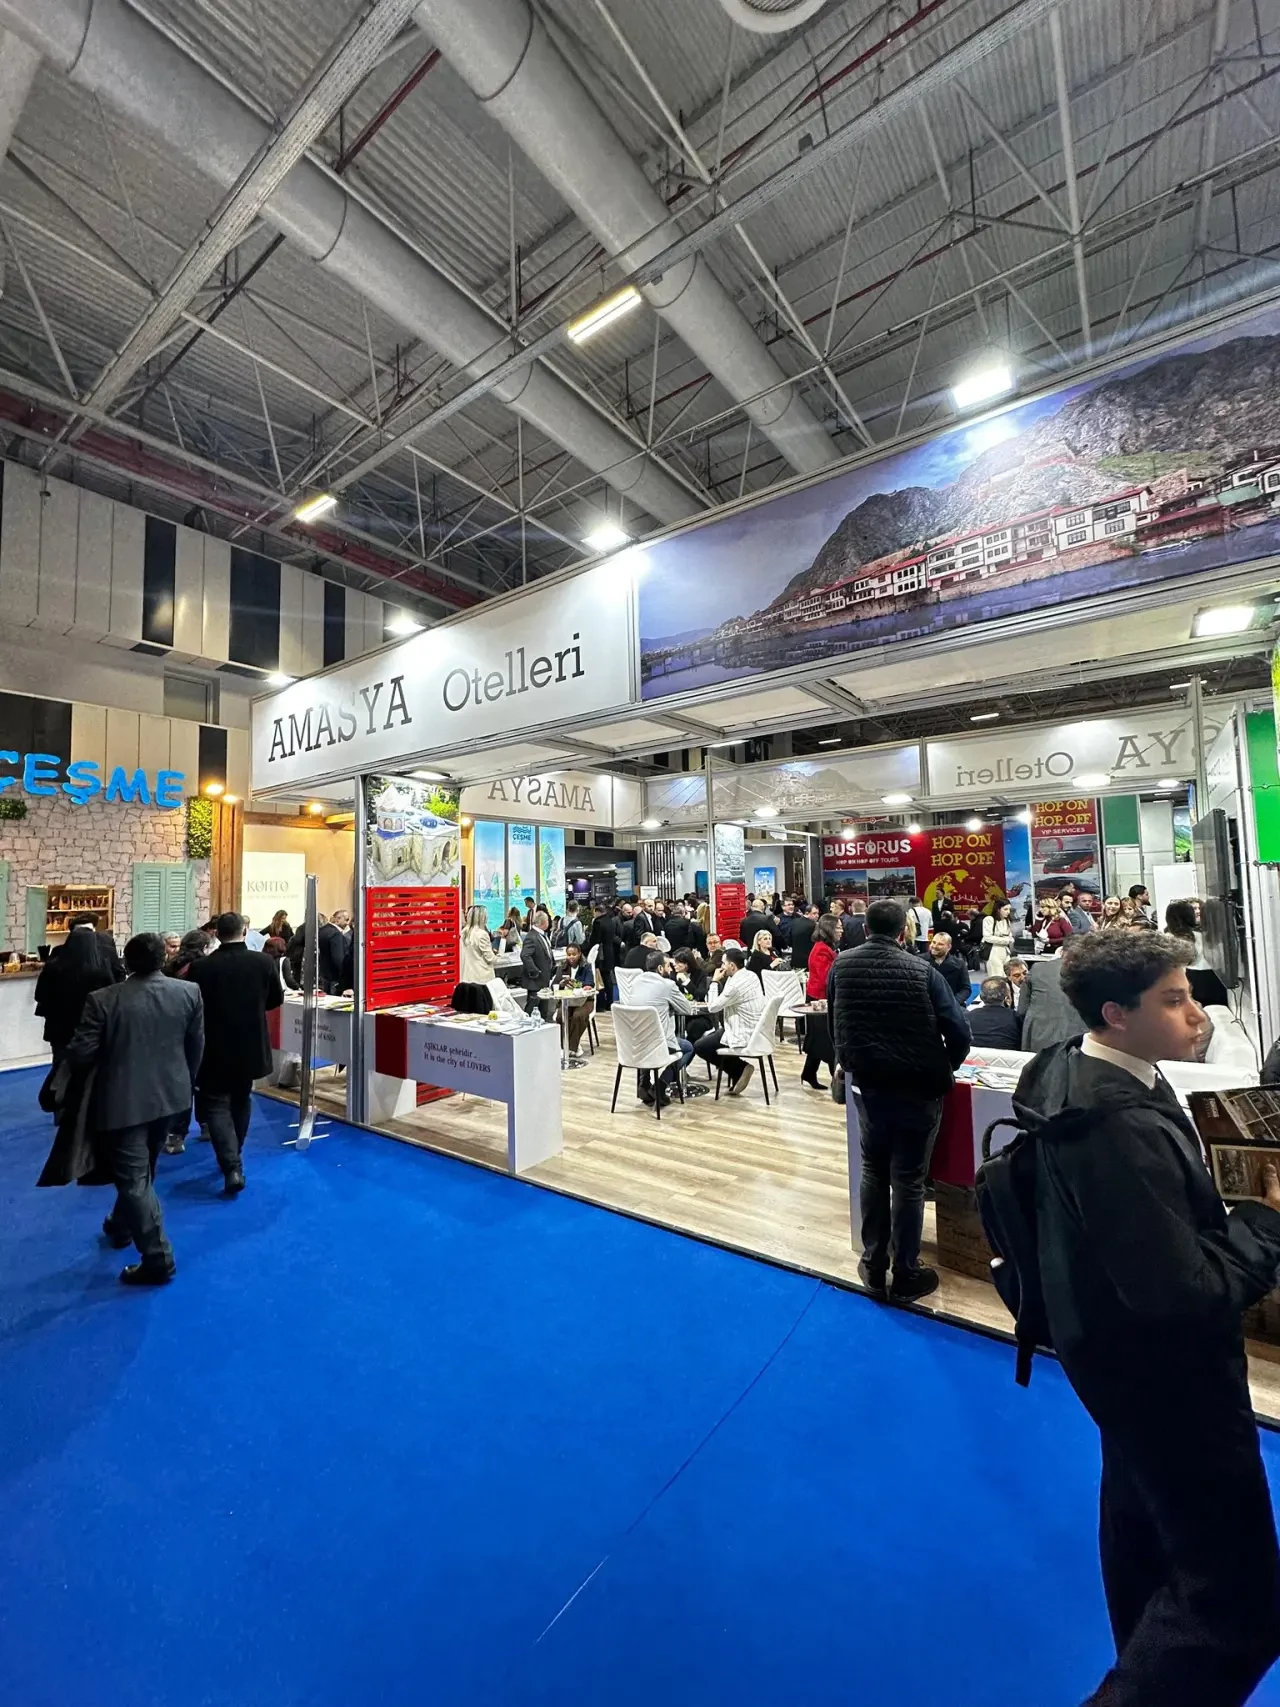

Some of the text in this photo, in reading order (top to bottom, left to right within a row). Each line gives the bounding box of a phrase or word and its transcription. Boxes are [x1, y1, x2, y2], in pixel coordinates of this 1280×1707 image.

[268, 632, 585, 762] AMASYA Otelleri
[932, 833, 992, 849] HOP ON
[931, 853, 963, 866] HOP
[424, 1052, 491, 1073] It is the city of LOVERS
